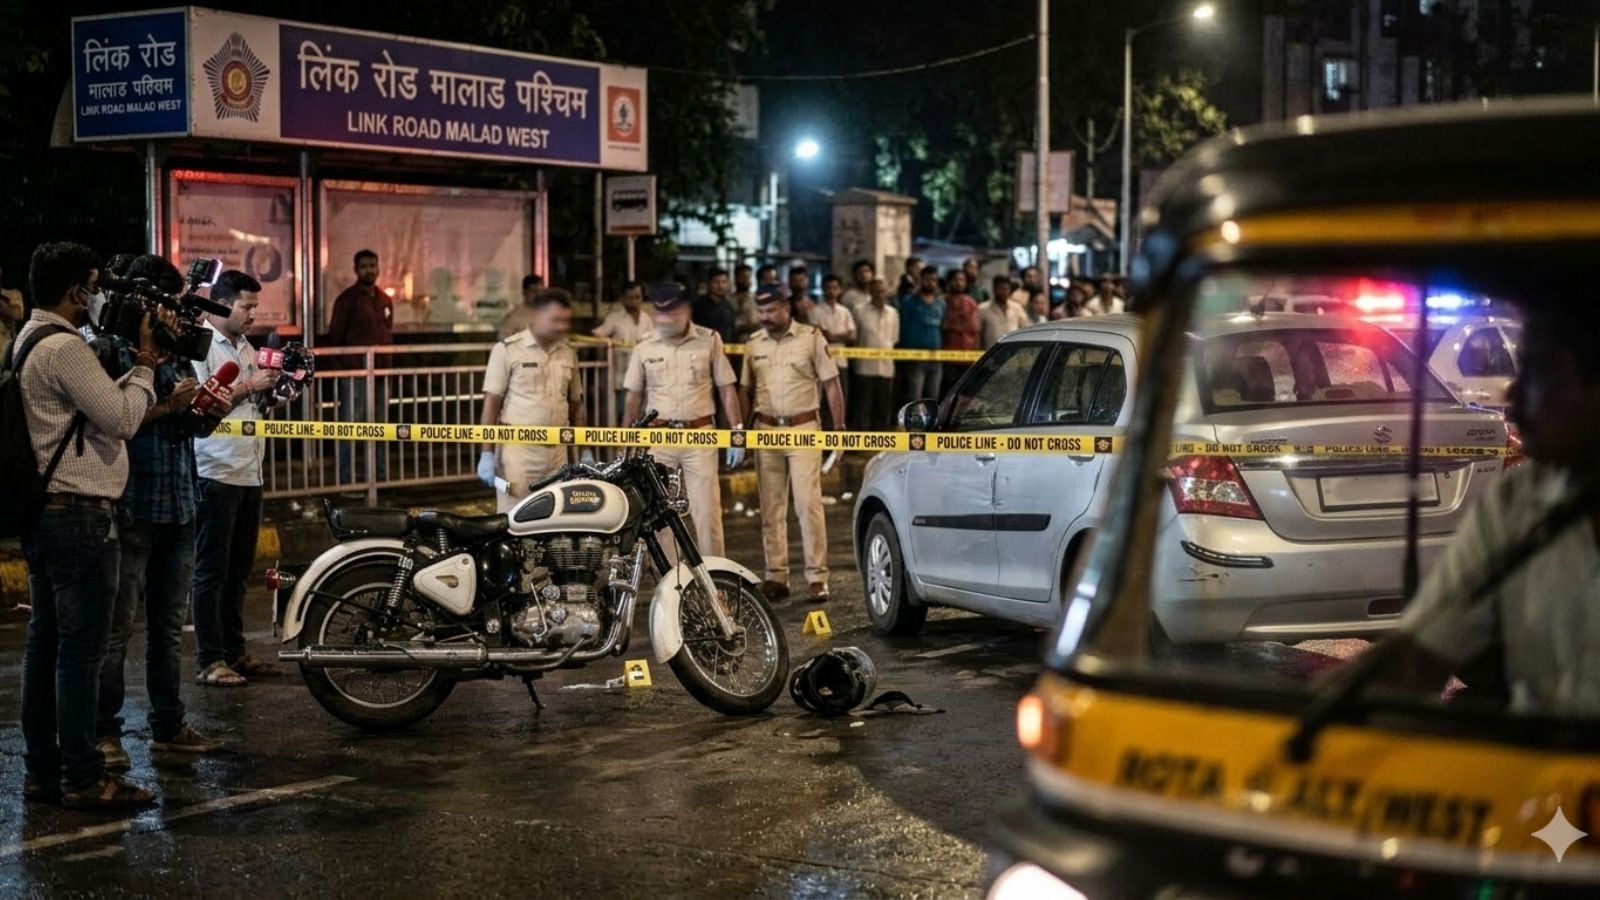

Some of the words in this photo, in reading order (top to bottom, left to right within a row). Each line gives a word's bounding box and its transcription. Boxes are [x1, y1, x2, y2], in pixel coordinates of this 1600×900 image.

[83, 38, 131, 74] लिंक
[138, 33, 176, 68] रोड
[297, 39, 359, 94] लिंक
[371, 49, 419, 101] रोड
[429, 69, 506, 110] मालाड
[515, 70, 588, 120] पश्चिम
[158, 100, 182, 111] WEST
[348, 110, 388, 136] LINK
[393, 115, 441, 140] ROAD
[445, 121, 503, 145] MALAD
[506, 126, 550, 149] WEST
[356, 425, 385, 438] CROSS
[518, 429, 548, 442] CROSS
[585, 430, 618, 443] POLICE
[686, 432, 718, 445] CROSS
[757, 433, 791, 446] POLICE
[794, 433, 815, 447] LINE
[842, 435, 861, 447] NOT
[864, 435, 896, 448] CROSS
[937, 436, 972, 449] POLICE
[975, 437, 997, 449] LINE
[1007, 437, 1021, 450] DO
[1024, 437, 1044, 450] NOT
[1047, 438, 1081, 451] CROSS
